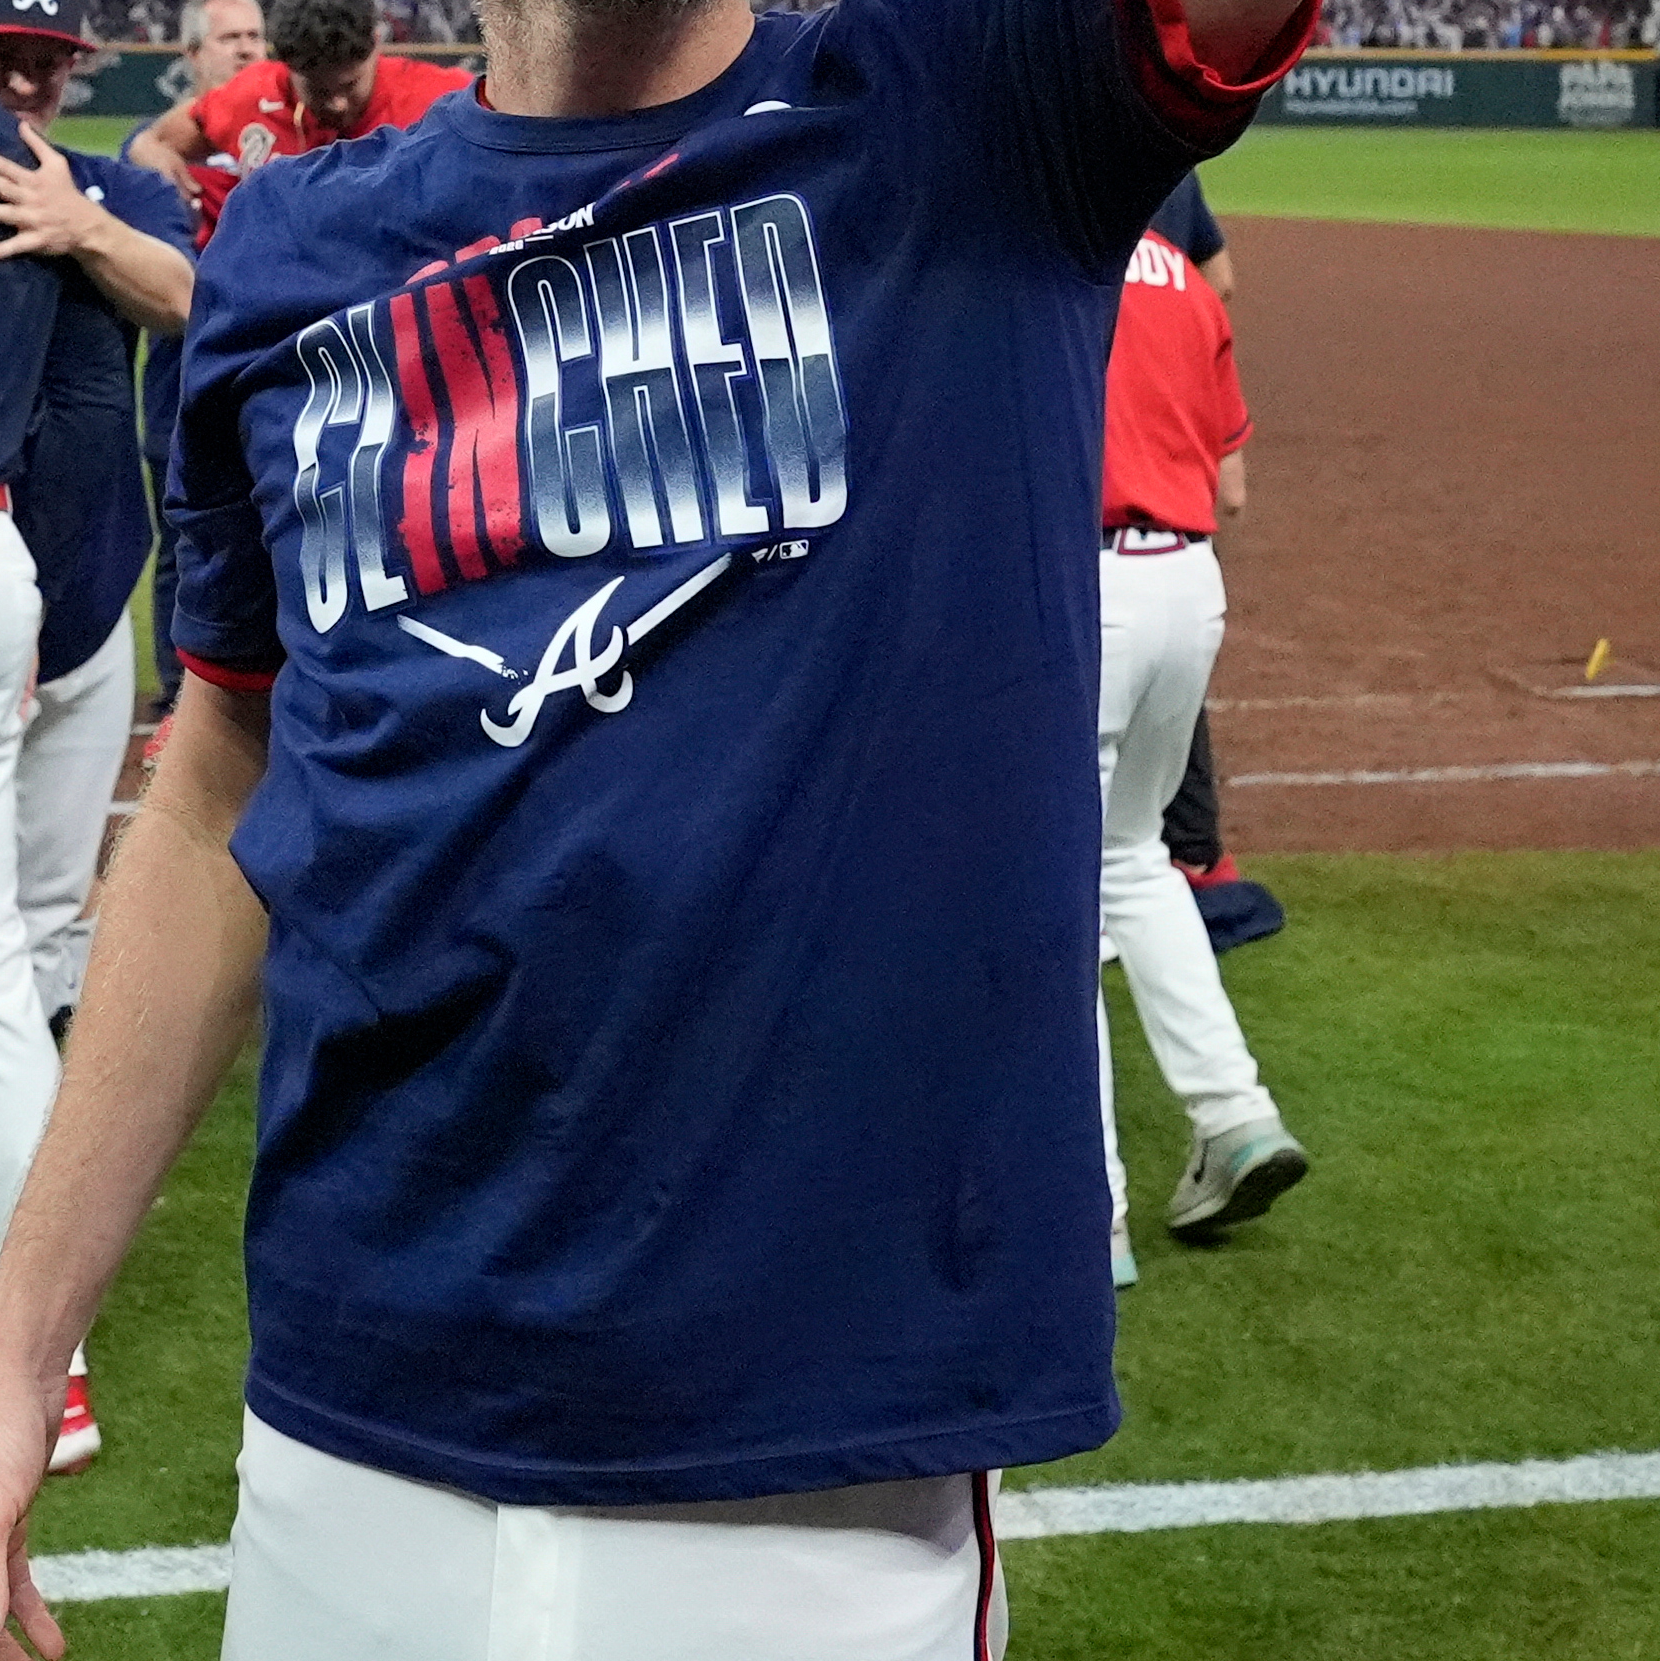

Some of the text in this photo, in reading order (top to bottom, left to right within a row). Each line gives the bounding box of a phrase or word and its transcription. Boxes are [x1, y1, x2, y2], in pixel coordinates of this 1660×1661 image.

[1284, 67, 1455, 99] HYUNDAI
[293, 191, 847, 635] CLINCHED
[480, 576, 633, 748] A
